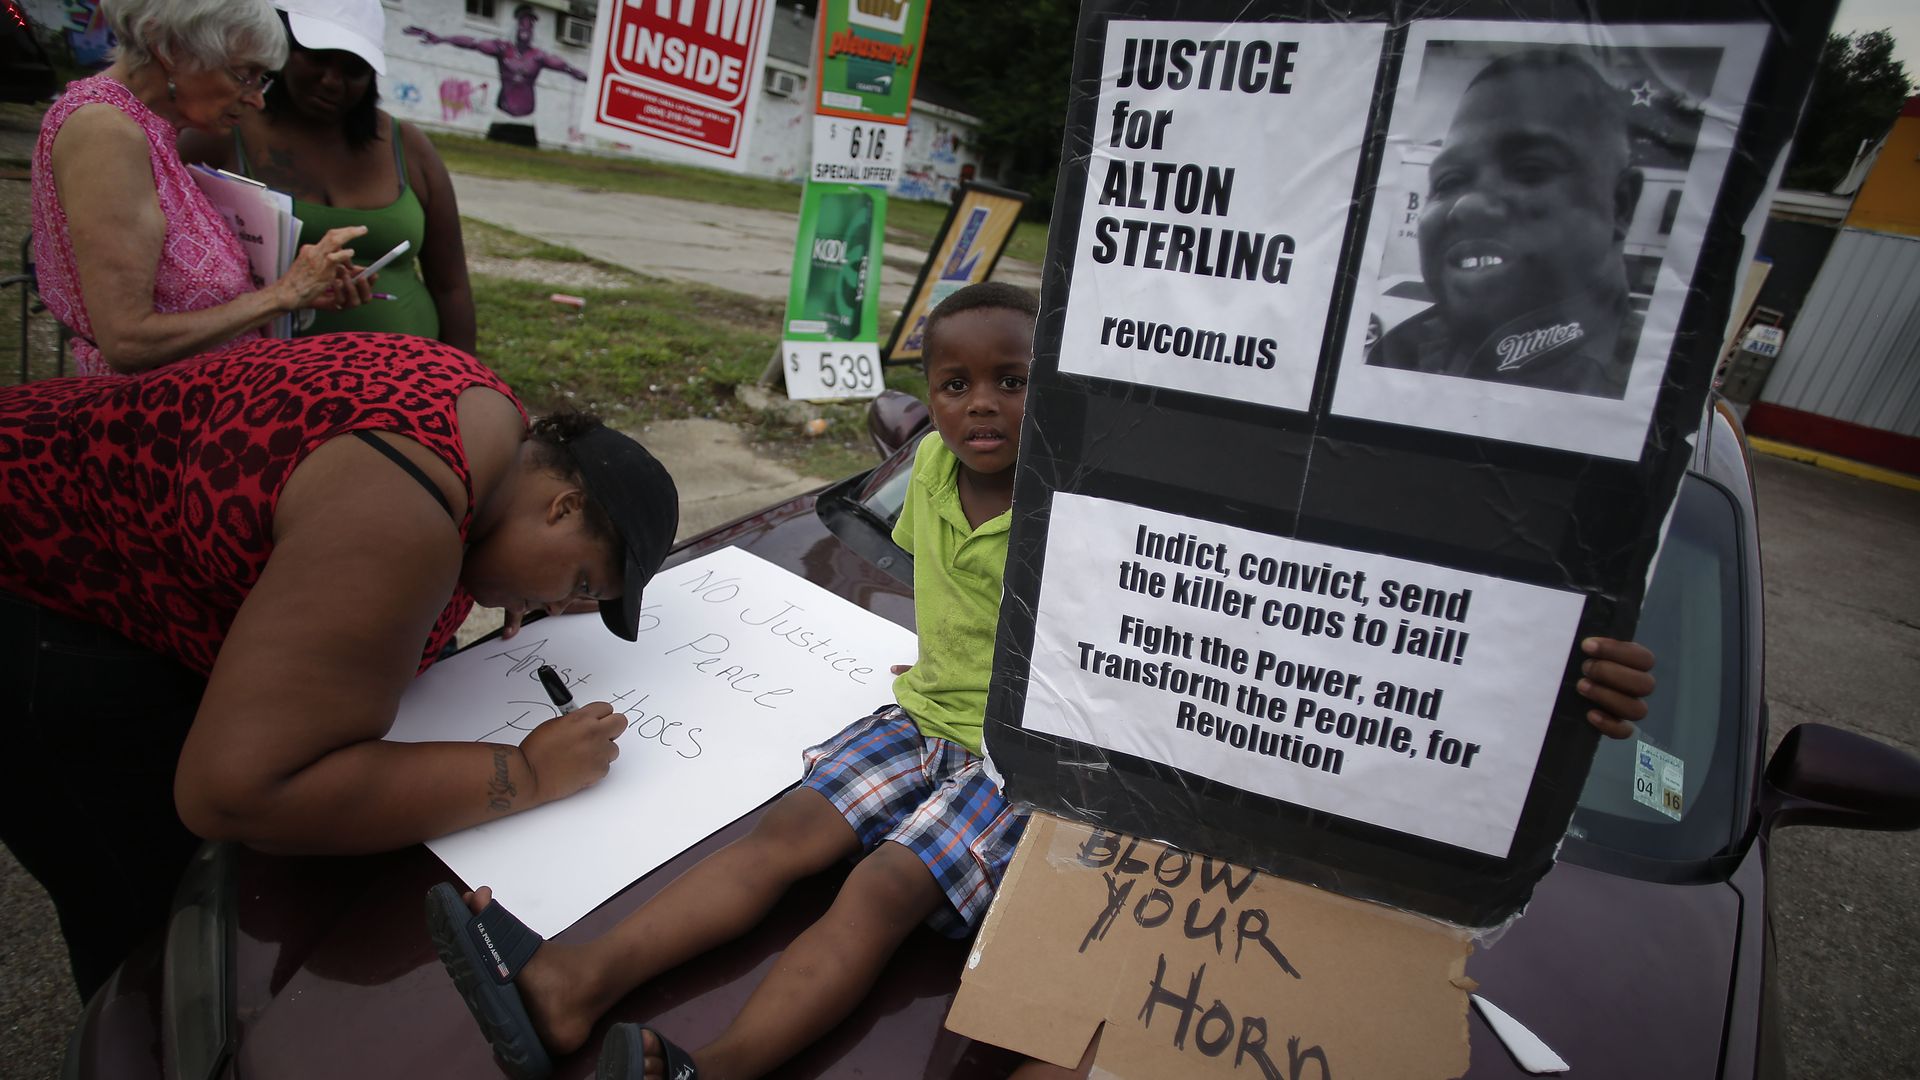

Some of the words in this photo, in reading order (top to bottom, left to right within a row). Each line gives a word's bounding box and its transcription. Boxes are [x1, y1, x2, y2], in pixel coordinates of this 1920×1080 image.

[625, 0, 750, 46] TM
[622, 22, 743, 94] INSIDE
[1116, 38, 1299, 94] JUSTICE
[1109, 100, 1174, 150] for
[816, 162, 860, 180] SPECIAL
[1098, 160, 1235, 216] ALTON
[813, 238, 848, 264] KOOL
[1092, 216, 1296, 284] STERLING
[1100, 316, 1277, 370] revcom.us
[1749, 340, 1775, 354] AIR
[790, 353, 799, 372] $
[820, 352, 874, 390] 539
[1135, 524, 1231, 579] Indict,
[1238, 551, 1370, 607] convict,
[1378, 577, 1472, 624] send
[1118, 560, 1166, 600] the
[1172, 571, 1258, 621] killer
[1261, 596, 1345, 640] cops
[1353, 612, 1389, 648] to
[1391, 618, 1470, 666] jail!
[1119, 614, 1194, 660] Fight
[1200, 635, 1249, 676] the
[1255, 650, 1364, 708] Power,
[1373, 679, 1444, 721] and
[1077, 641, 1231, 706] Transform
[1236, 682, 1288, 724] the
[1294, 699, 1417, 759] People,
[1425, 728, 1481, 769] for
[1176, 700, 1345, 775] Revolution
[1637, 778, 1653, 796] 04
[1665, 791, 1681, 810] 16
[482, 932, 494, 949] POLO
